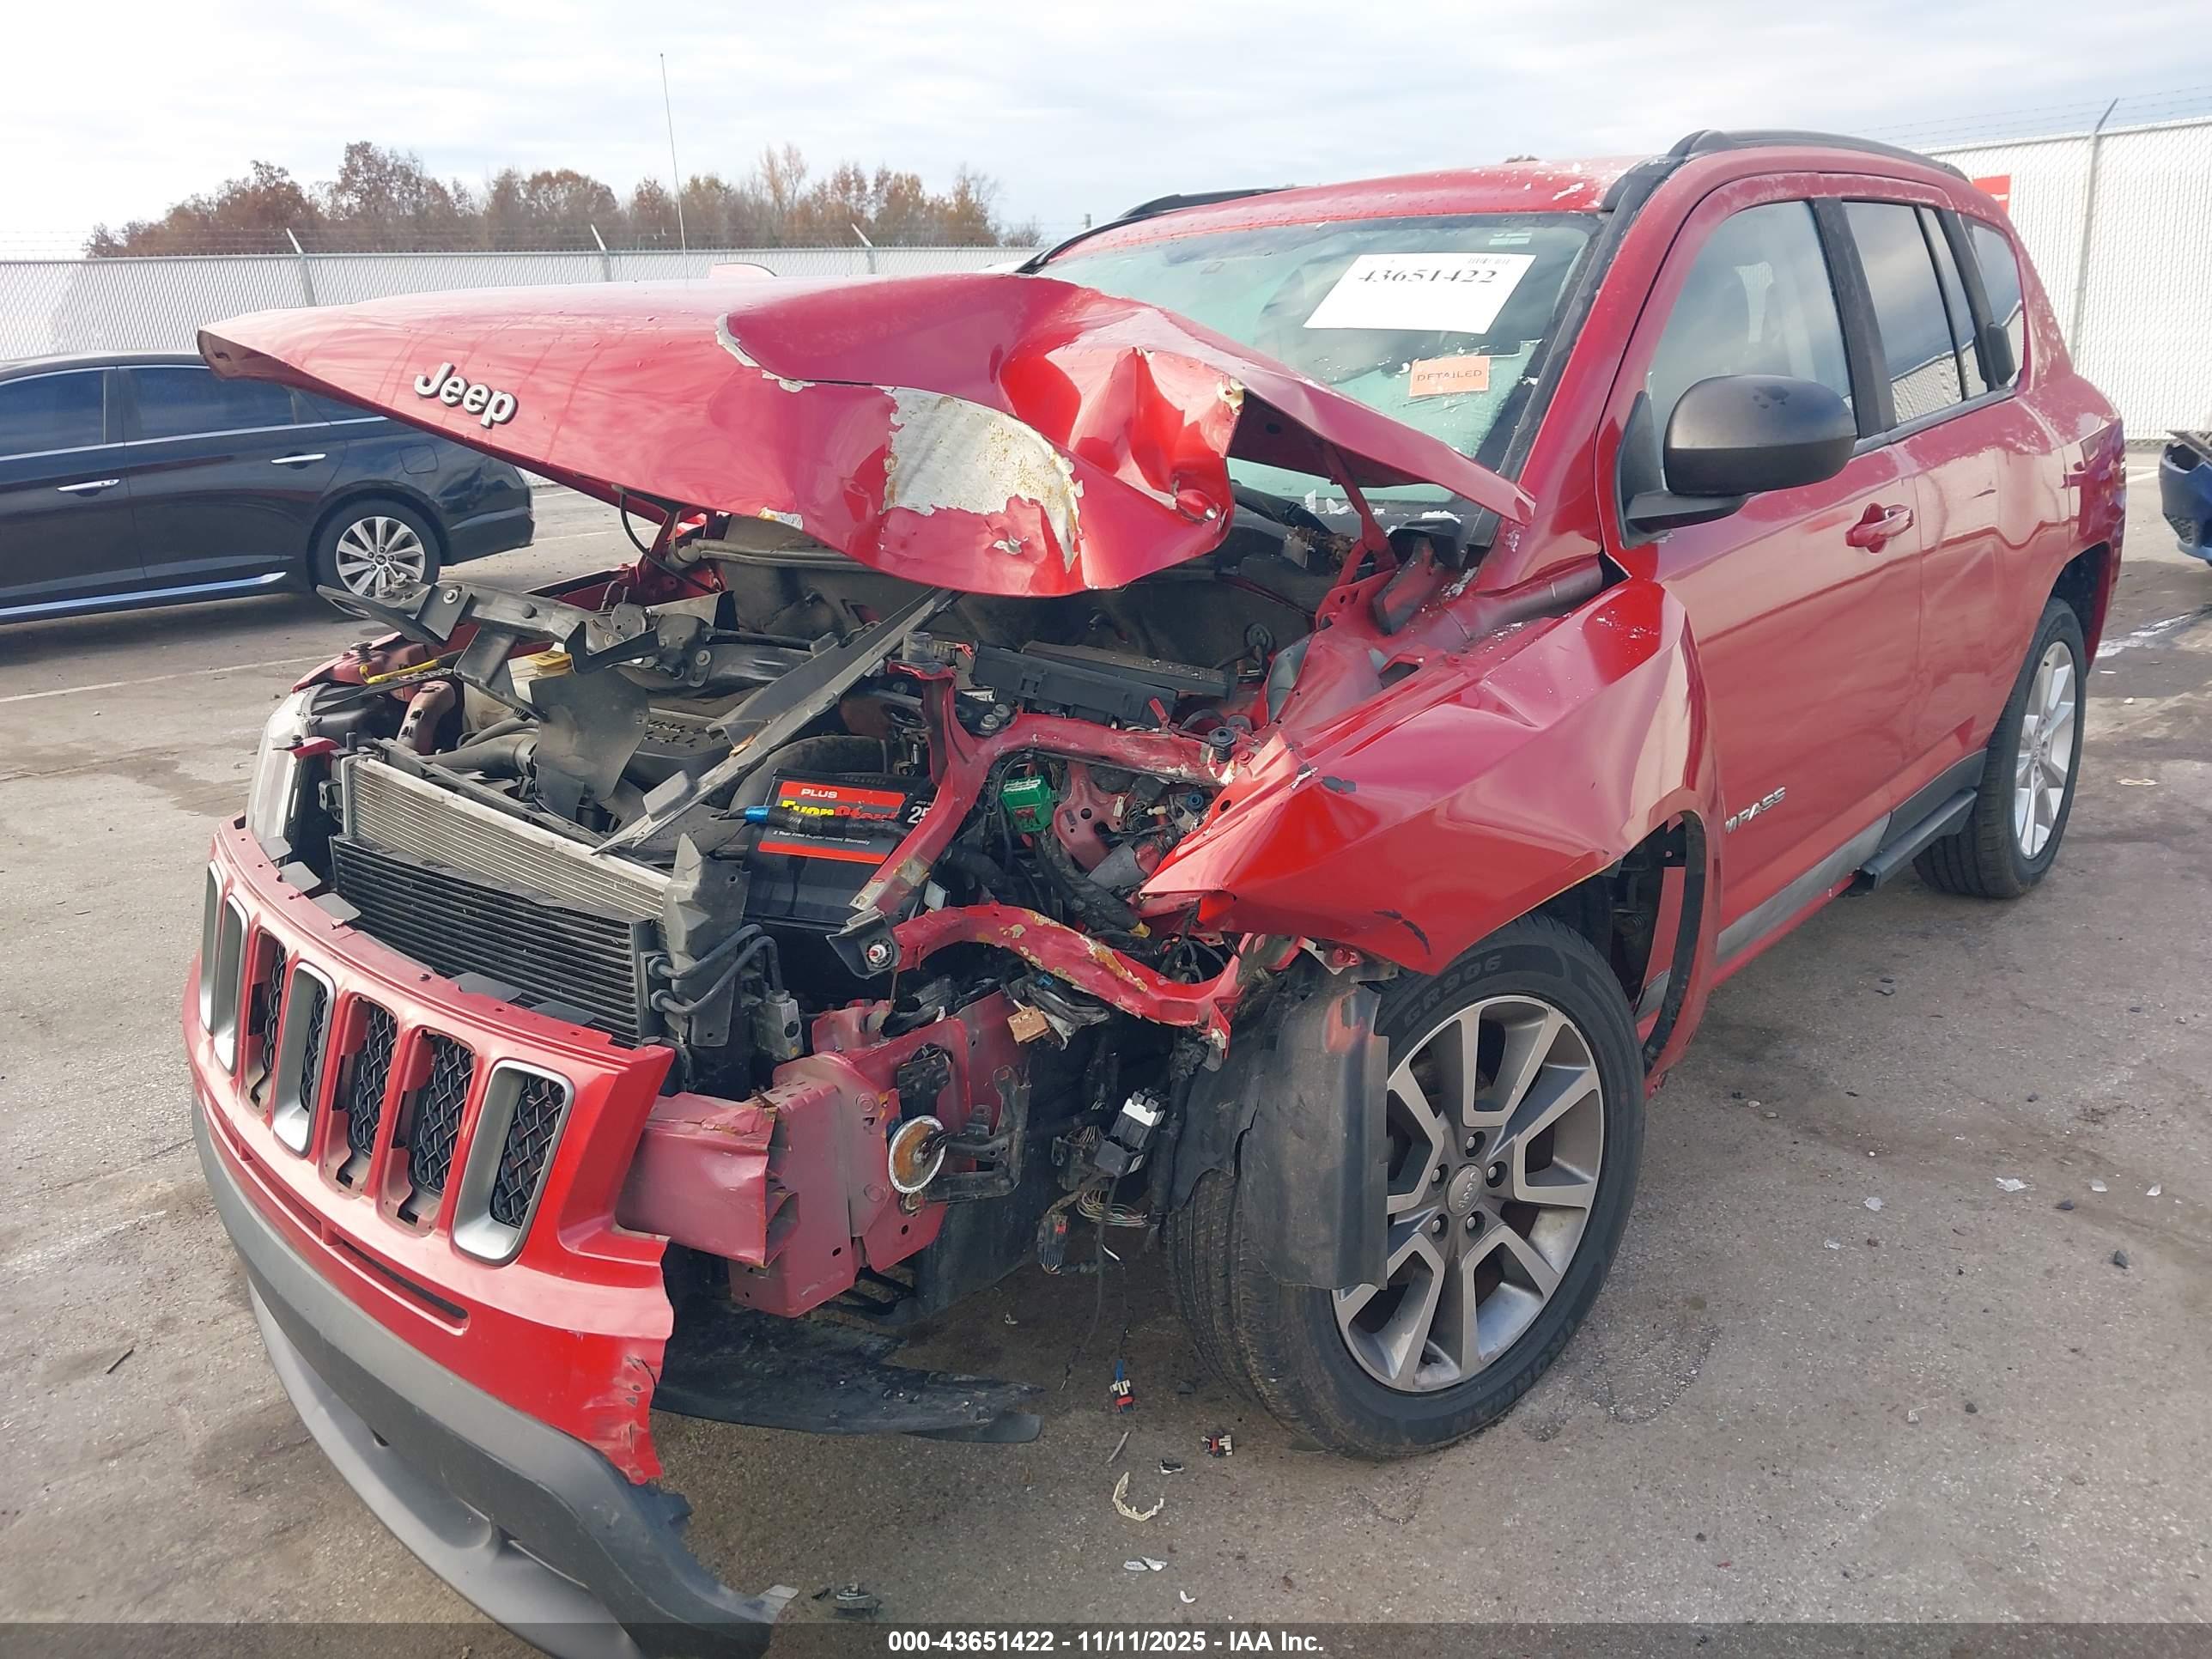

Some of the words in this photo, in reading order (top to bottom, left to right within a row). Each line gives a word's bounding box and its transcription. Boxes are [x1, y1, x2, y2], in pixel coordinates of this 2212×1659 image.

[1358, 270, 1498, 283] 43651422
[1417, 369, 1484, 382] DETAILED
[413, 362, 520, 429] Jeep
[800, 787, 838, 799] PLUS
[1404, 955, 1503, 1028] GR906
[1458, 1172, 1476, 1209] Jeep
